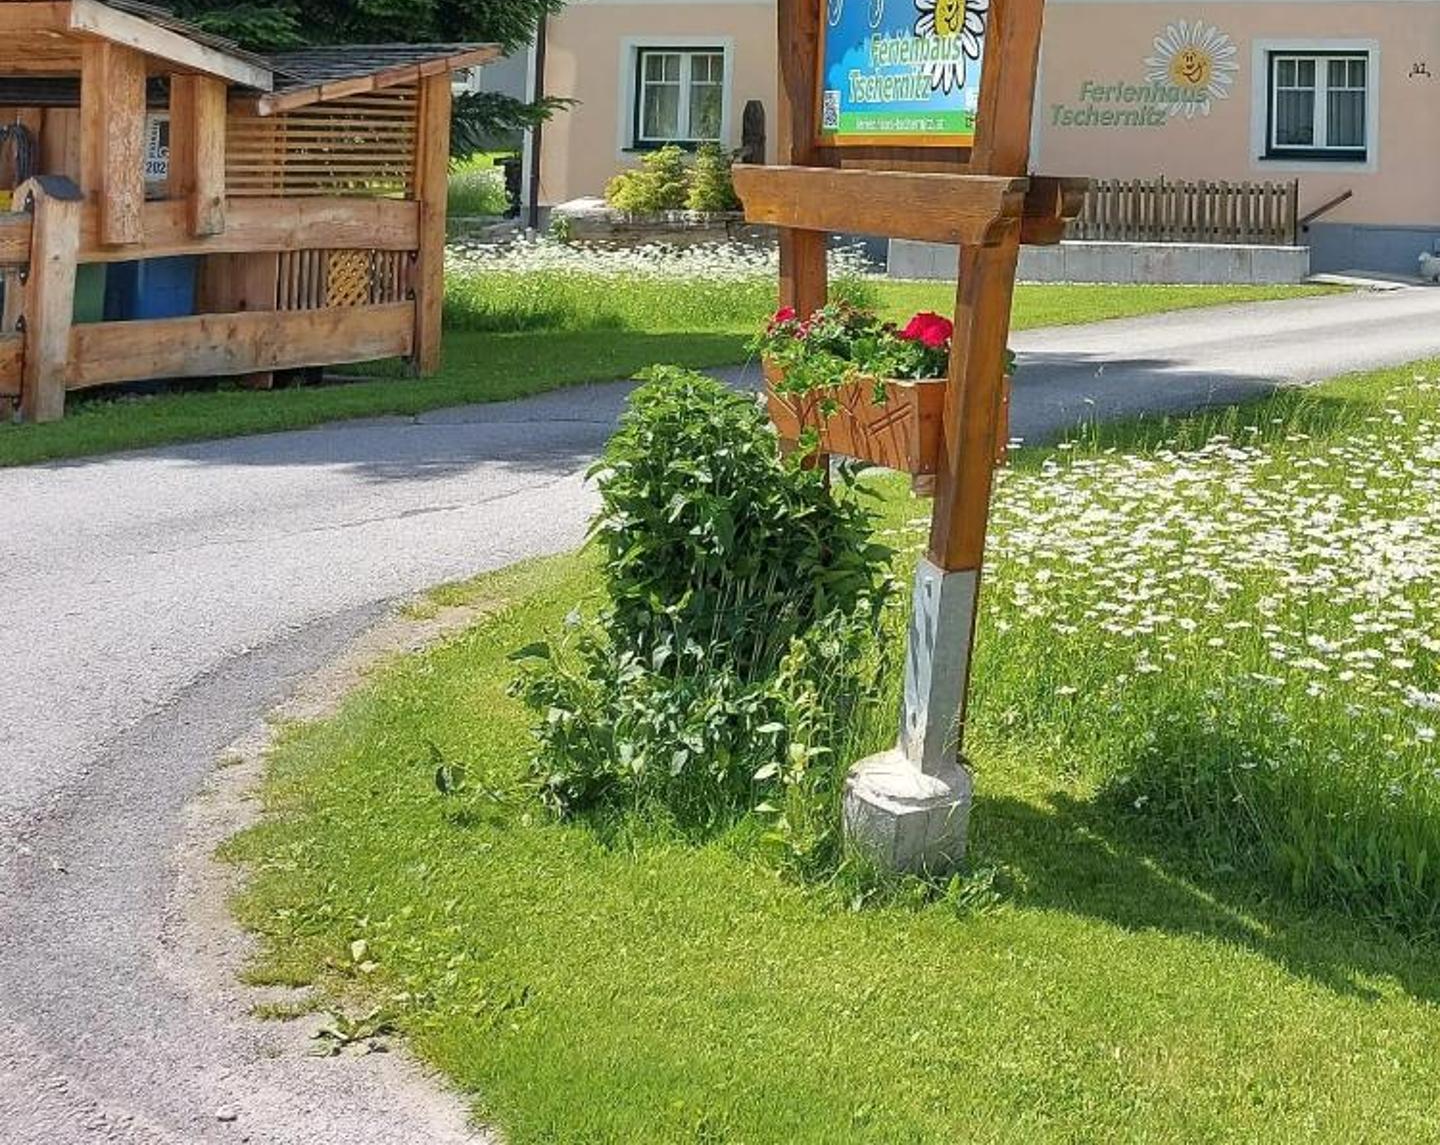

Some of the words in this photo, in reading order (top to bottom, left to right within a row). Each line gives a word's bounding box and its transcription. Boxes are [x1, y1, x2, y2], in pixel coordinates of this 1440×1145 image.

[869, 31, 962, 65] Ferienhaus
[849, 67, 932, 103] Tschernitz
[1080, 80, 1207, 103] Ferienhaus
[1051, 104, 1168, 127] Tschernitz
[145, 161, 169, 175] 202
